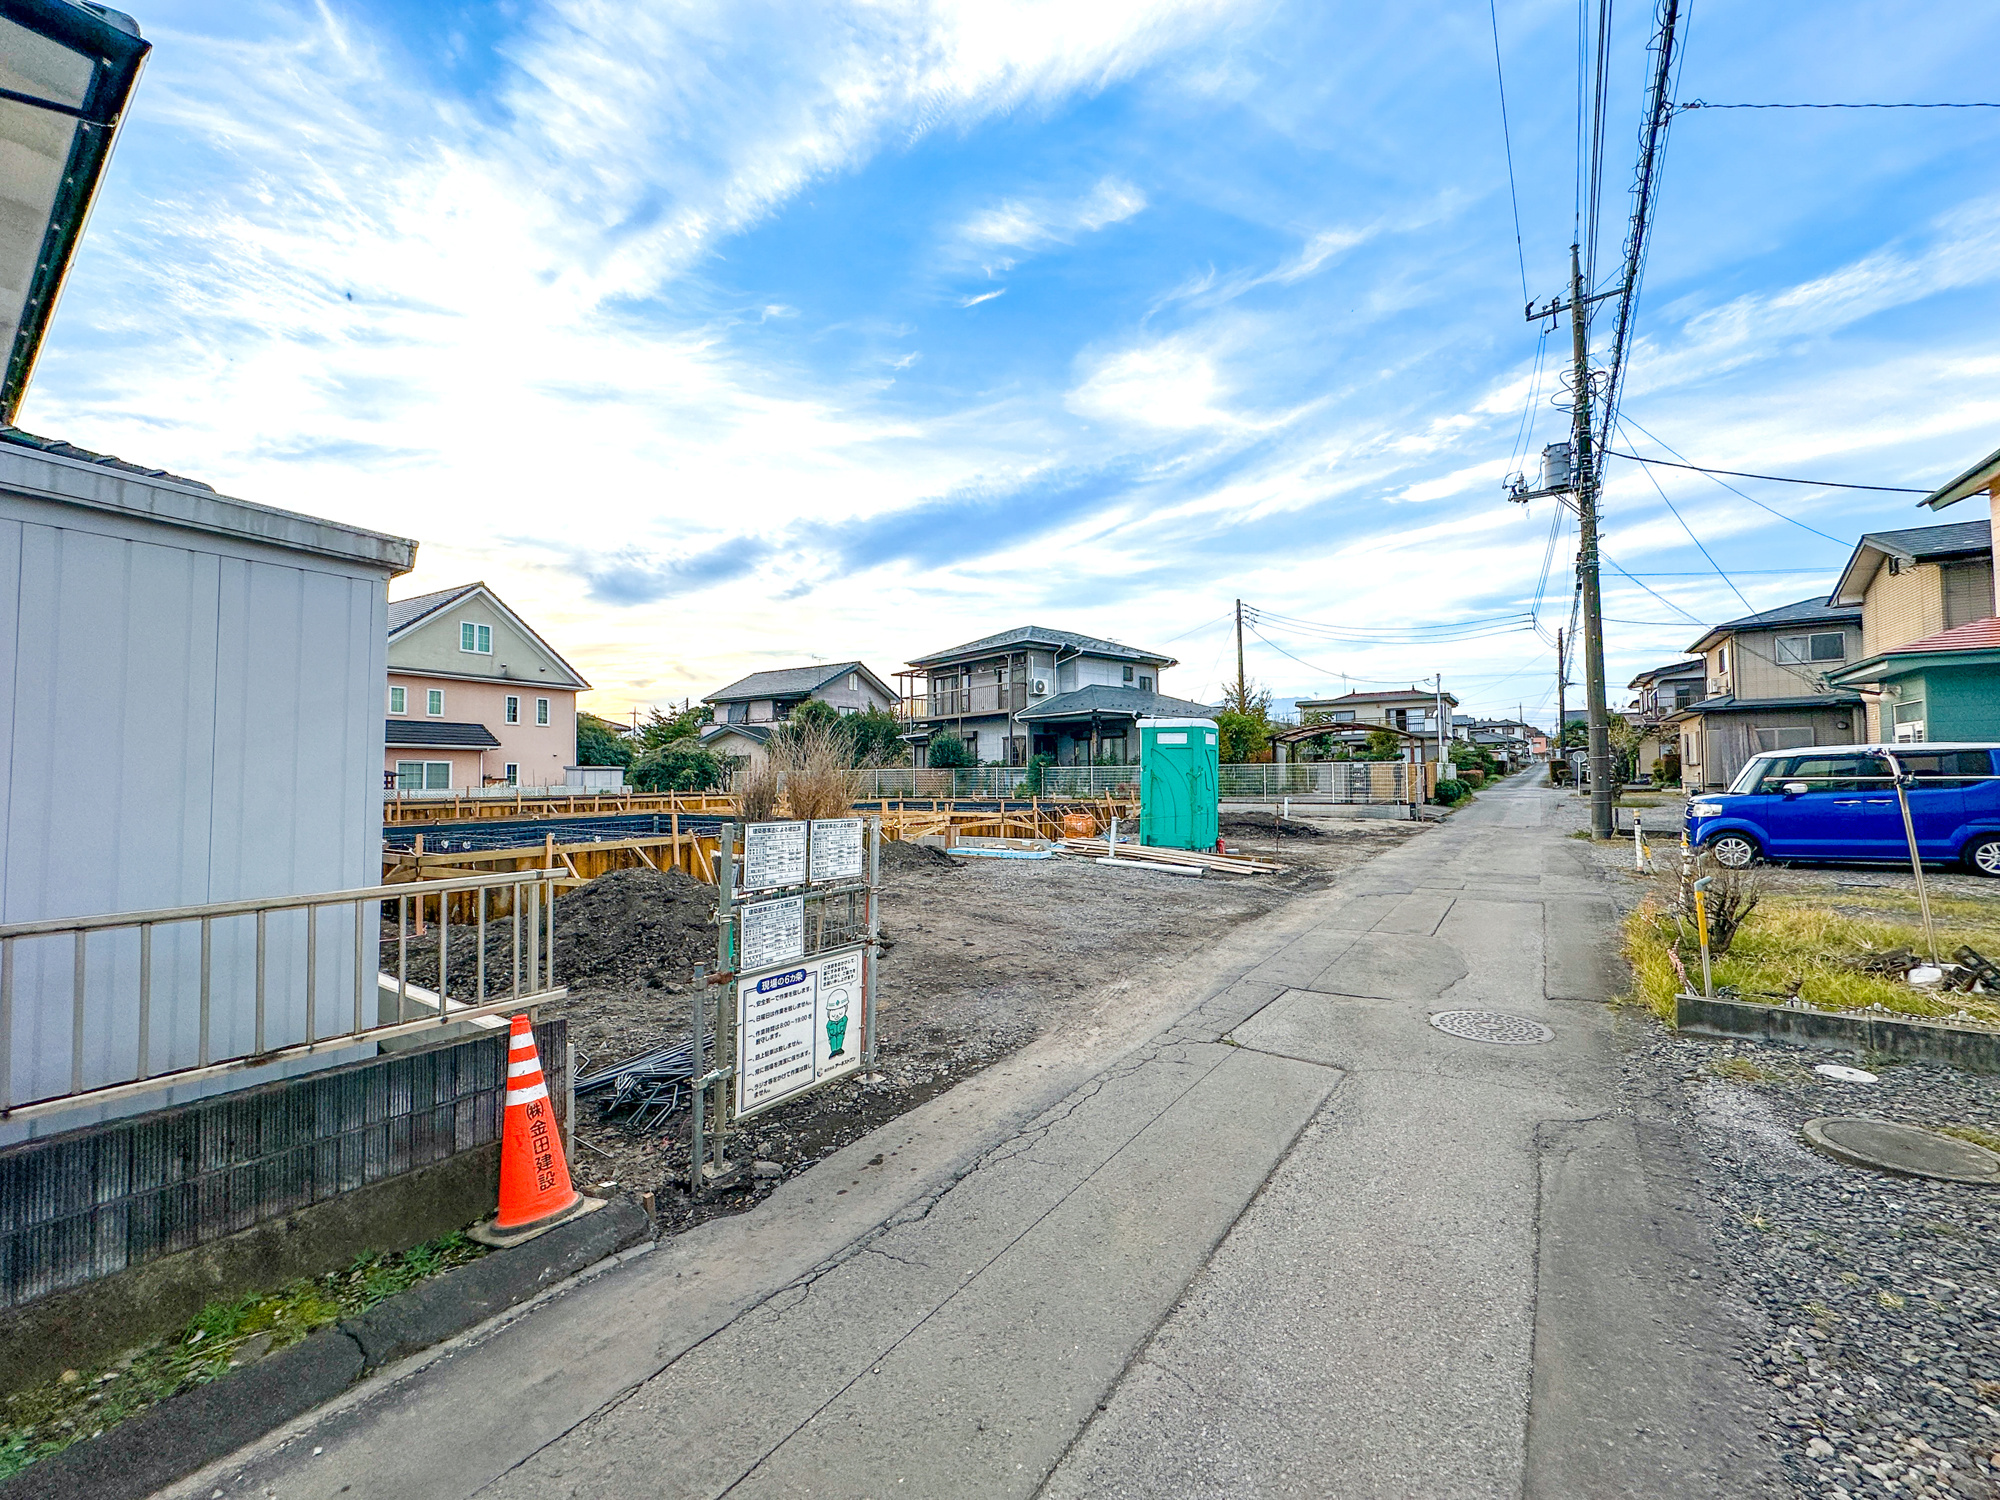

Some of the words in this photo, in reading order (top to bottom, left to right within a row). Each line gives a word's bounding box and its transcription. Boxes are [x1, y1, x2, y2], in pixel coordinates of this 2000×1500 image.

[761, 971, 803, 991] 現場の6カ条
